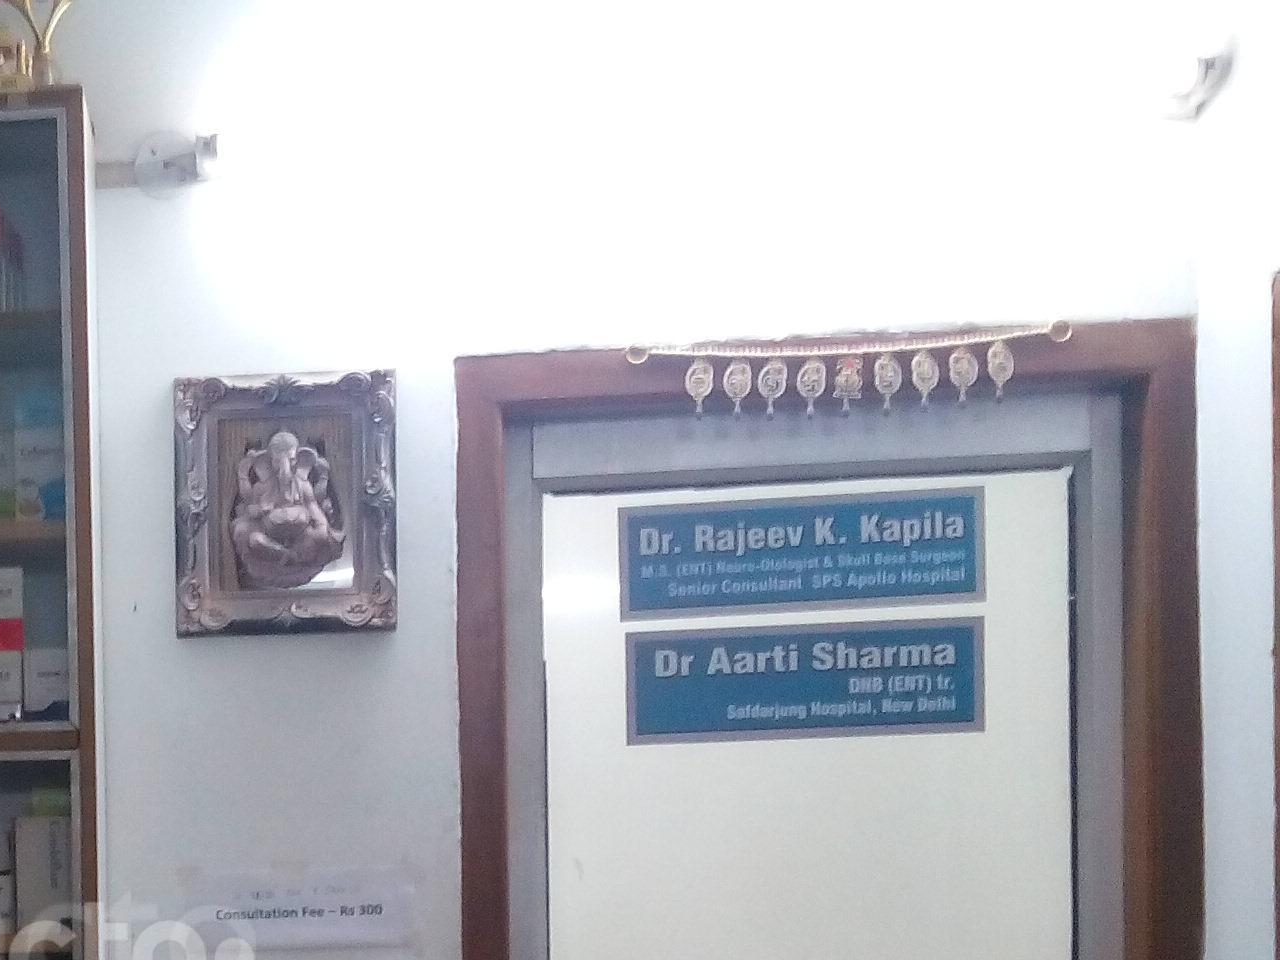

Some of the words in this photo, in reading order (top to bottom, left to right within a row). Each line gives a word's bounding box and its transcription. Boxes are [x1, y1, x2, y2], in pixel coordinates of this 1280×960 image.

[638, 527, 682, 556] Dr.
[694, 521, 804, 557] Rajeev
[814, 516, 848, 546] K.
[859, 510, 966, 547] Kapila
[824, 555, 834, 568] &
[667, 581, 718, 599] Senior
[721, 576, 803, 595] Consultant
[846, 571, 898, 591] Apollo
[900, 566, 966, 586] Hospital
[654, 650, 694, 678] Dr
[706, 643, 799, 676] Aarti
[811, 640, 956, 671] Sharma
[881, 697, 914, 714] New
[917, 695, 957, 713] Delhi
[216, 907, 299, 921] Consultation
[301, 905, 325, 918] Fee
[340, 905, 355, 917] Rs
[358, 904, 384, 916] 300
